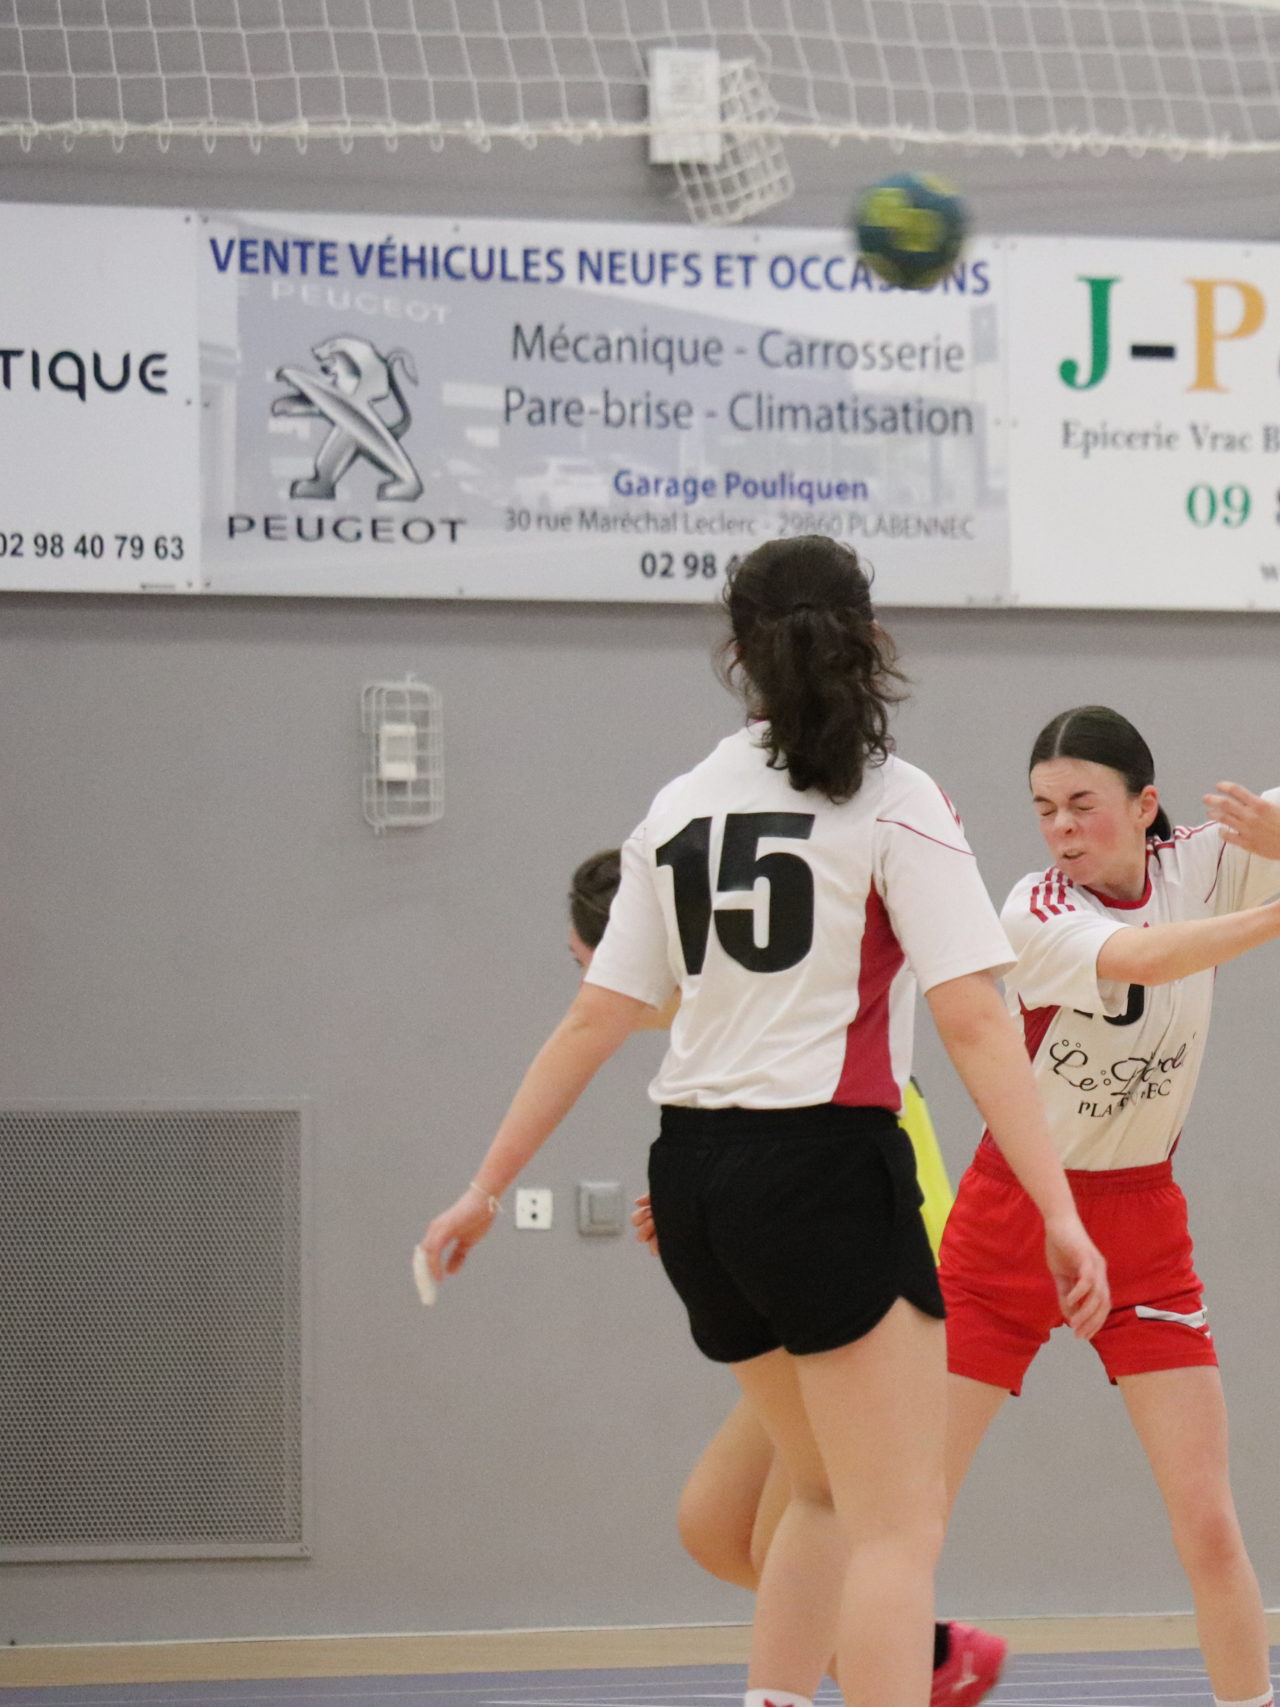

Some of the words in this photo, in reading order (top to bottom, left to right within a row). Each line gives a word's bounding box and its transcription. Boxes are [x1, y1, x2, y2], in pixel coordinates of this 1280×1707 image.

[209, 237, 339, 276] VENTE
[348, 236, 564, 285] VÉHICULES
[577, 249, 702, 287] NEUFS
[714, 253, 758, 288] ET
[769, 255, 990, 295] OCCANS
[271, 280, 450, 324] PEUGEOT
[511, 322, 724, 374] Mécanique
[757, 328, 965, 373] Carrosserie
[503, 386, 693, 430] Pare-brise
[728, 391, 974, 436] Climatisation
[1061, 418, 1180, 459] Epicerie
[1189, 421, 1250, 453] Vrac
[613, 469, 717, 506] Garage
[724, 470, 869, 507] Pouliquen
[1185, 483, 1252, 529] 09
[227, 514, 468, 544] PEUGEOT
[504, 509, 532, 532] 30
[536, 514, 573, 533] rue
[577, 509, 678, 536] Maréchal
[682, 511, 756, 536] Leclerc
[848, 512, 976, 540] PLABENNEC
[33, 533, 65, 559] 98
[73, 534, 105, 560] 40
[114, 535, 145, 561] 79
[154, 536, 184, 561] 63
[640, 551, 674, 579] 02
[682, 551, 717, 579] 98
[655, 811, 816, 977] 15
